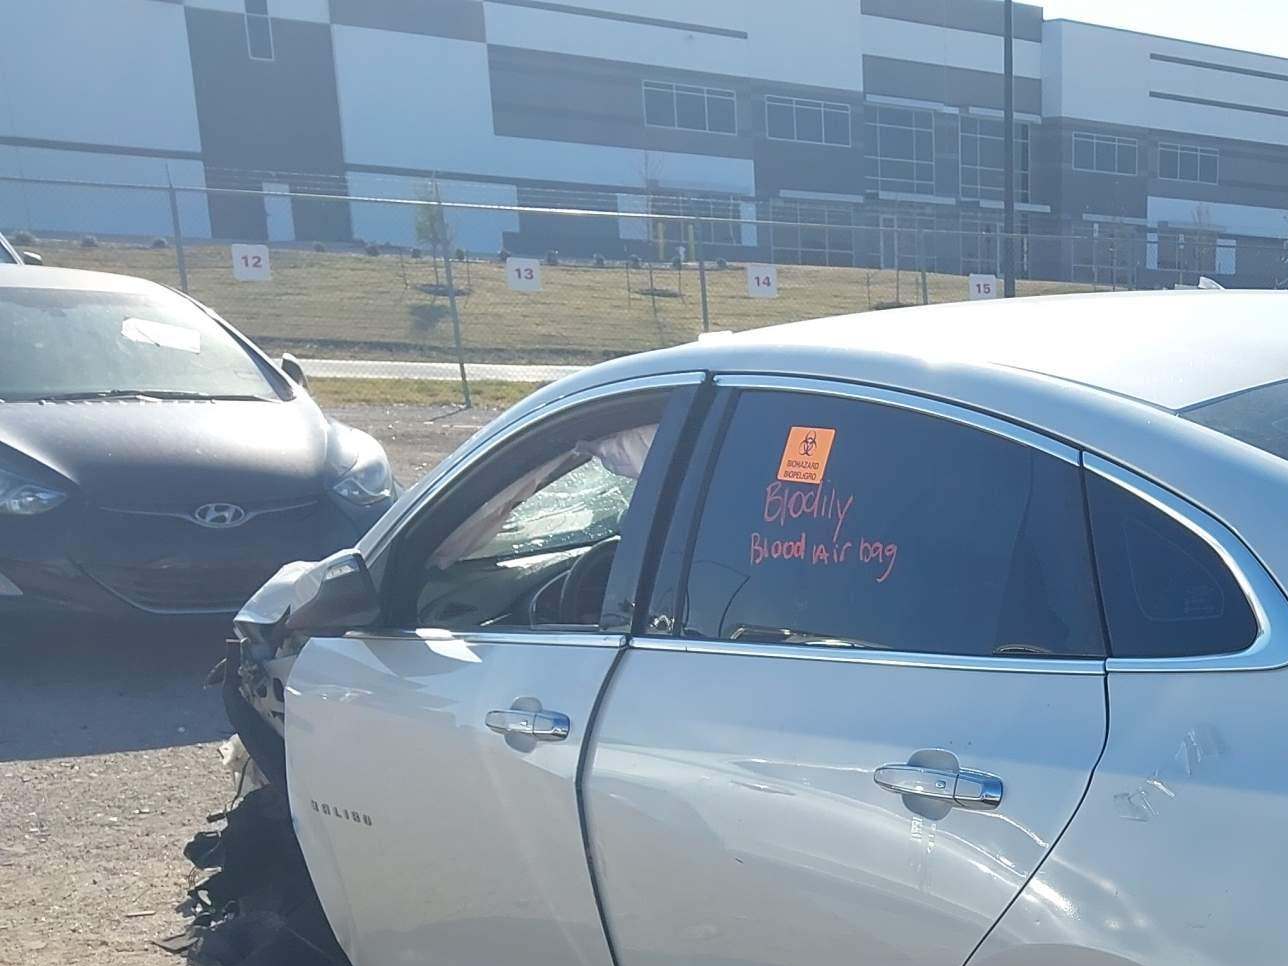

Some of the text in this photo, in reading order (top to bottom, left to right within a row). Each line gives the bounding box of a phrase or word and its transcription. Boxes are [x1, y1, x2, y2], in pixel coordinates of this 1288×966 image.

[241, 255, 263, 269] 12
[514, 267, 534, 280] 13
[754, 276, 772, 288] 14
[975, 283, 992, 295] 15
[787, 460, 819, 470] BIOHAZARD
[783, 471, 817, 481] BIOPELIGRO
[750, 532, 806, 567] Blood
[859, 536, 898, 583] bag
